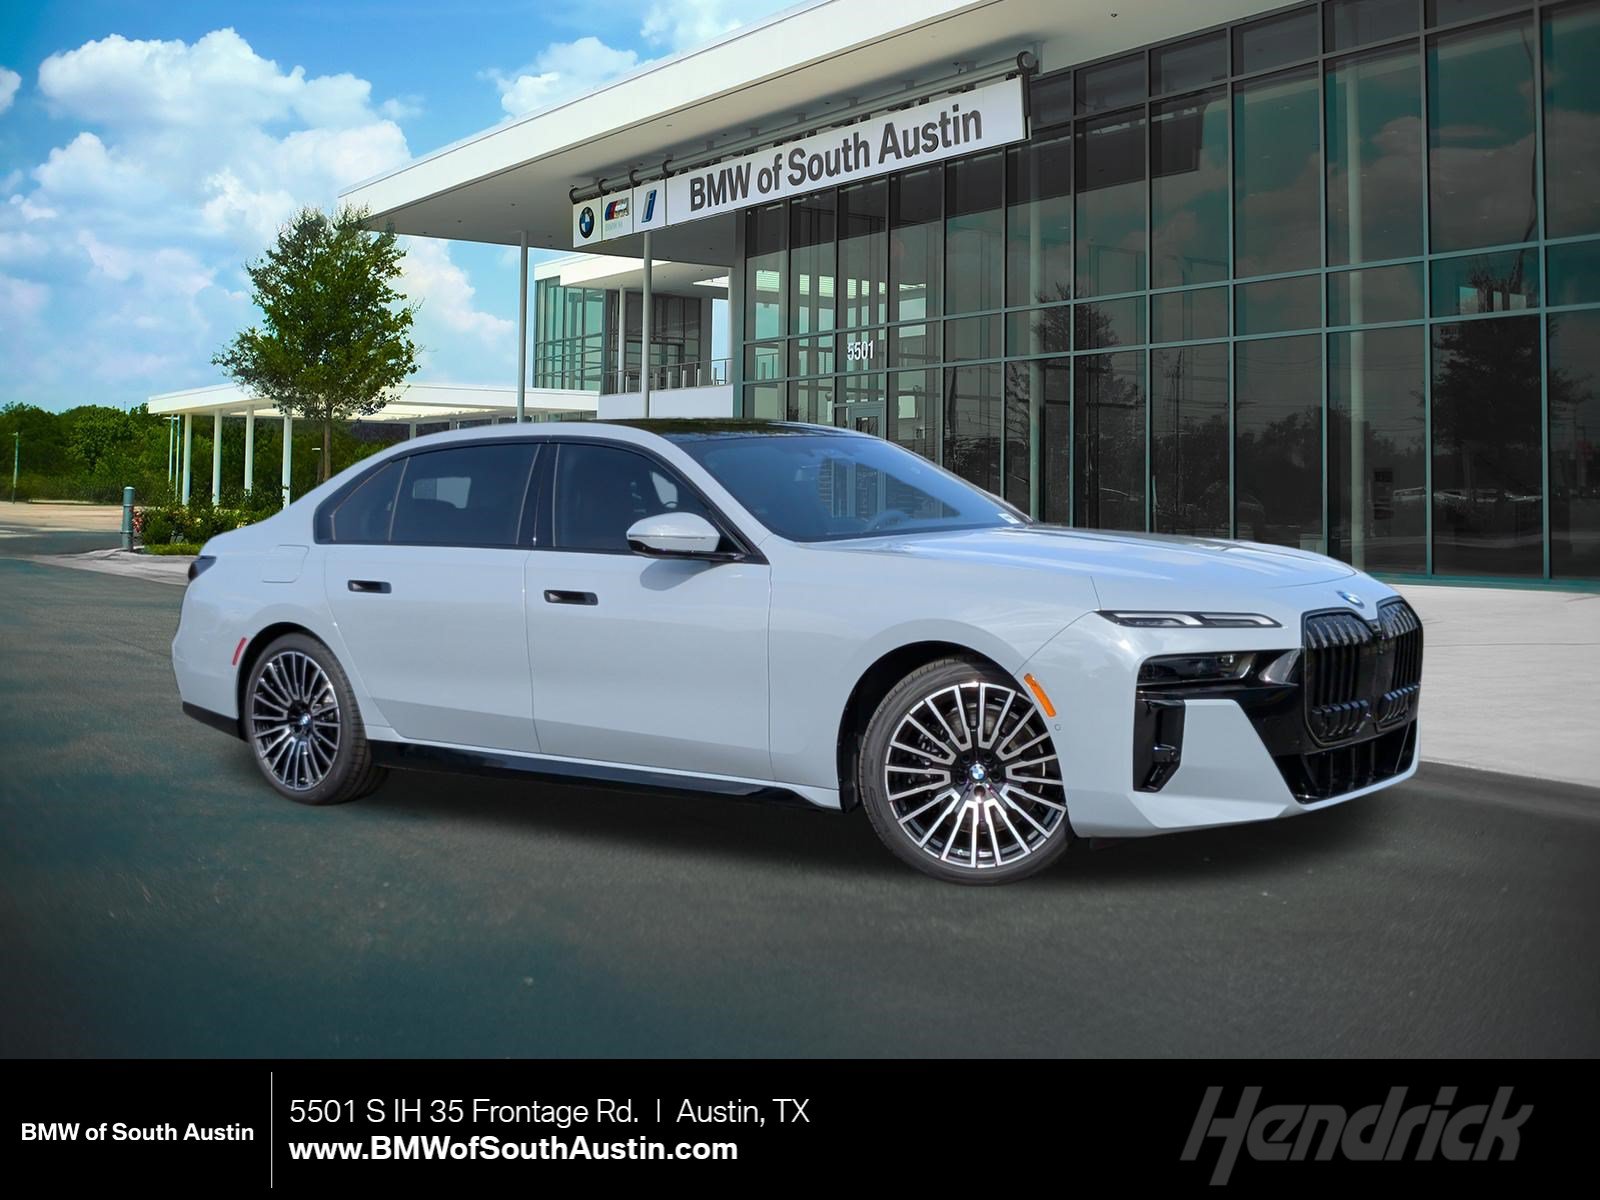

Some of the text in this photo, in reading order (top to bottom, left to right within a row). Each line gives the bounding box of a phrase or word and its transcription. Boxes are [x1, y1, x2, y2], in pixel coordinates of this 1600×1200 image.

[690, 104, 982, 211] BMW of South Austin
[847, 340, 874, 361] 5501
